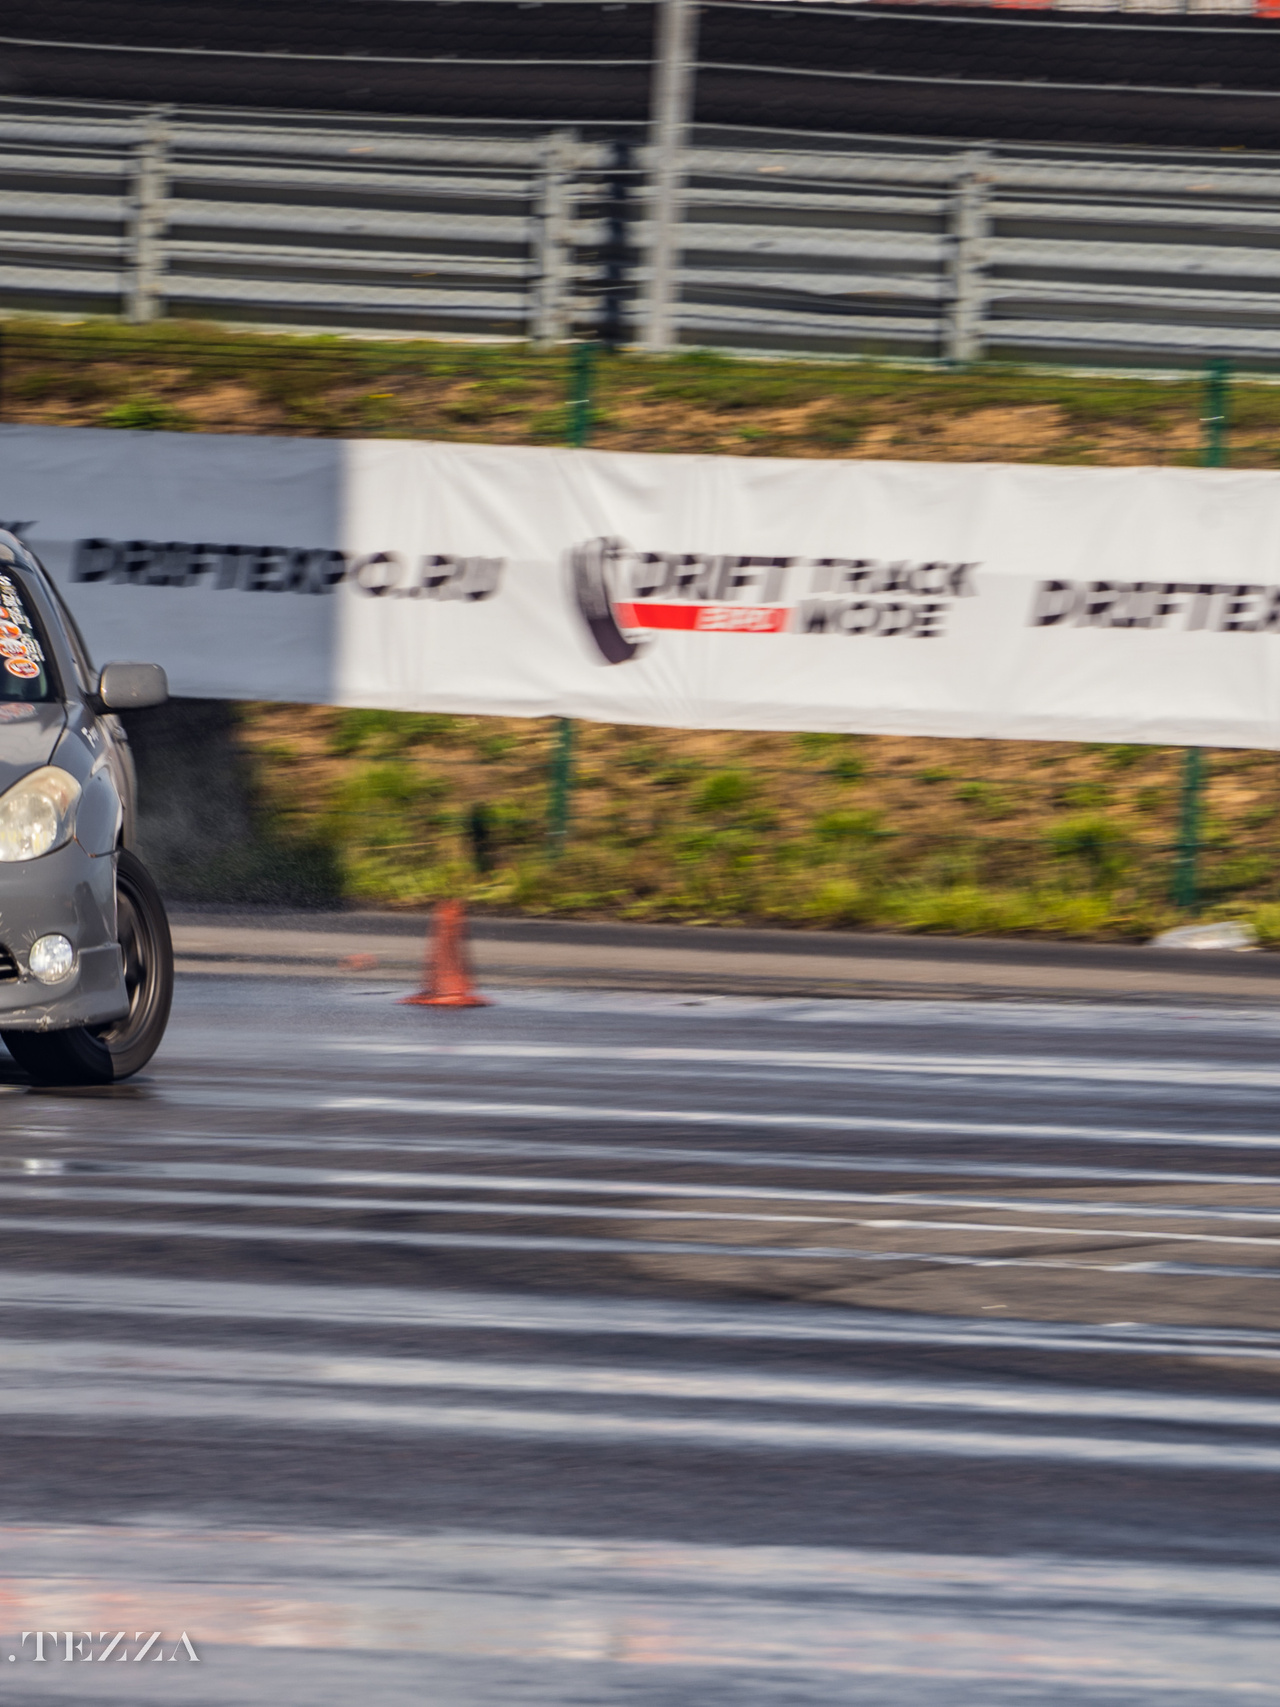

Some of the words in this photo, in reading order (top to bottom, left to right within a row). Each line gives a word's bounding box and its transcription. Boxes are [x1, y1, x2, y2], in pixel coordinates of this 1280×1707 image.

[622, 552, 803, 602] DRIFT
[807, 557, 985, 598] TRACK
[796, 599, 953, 638] MODE
